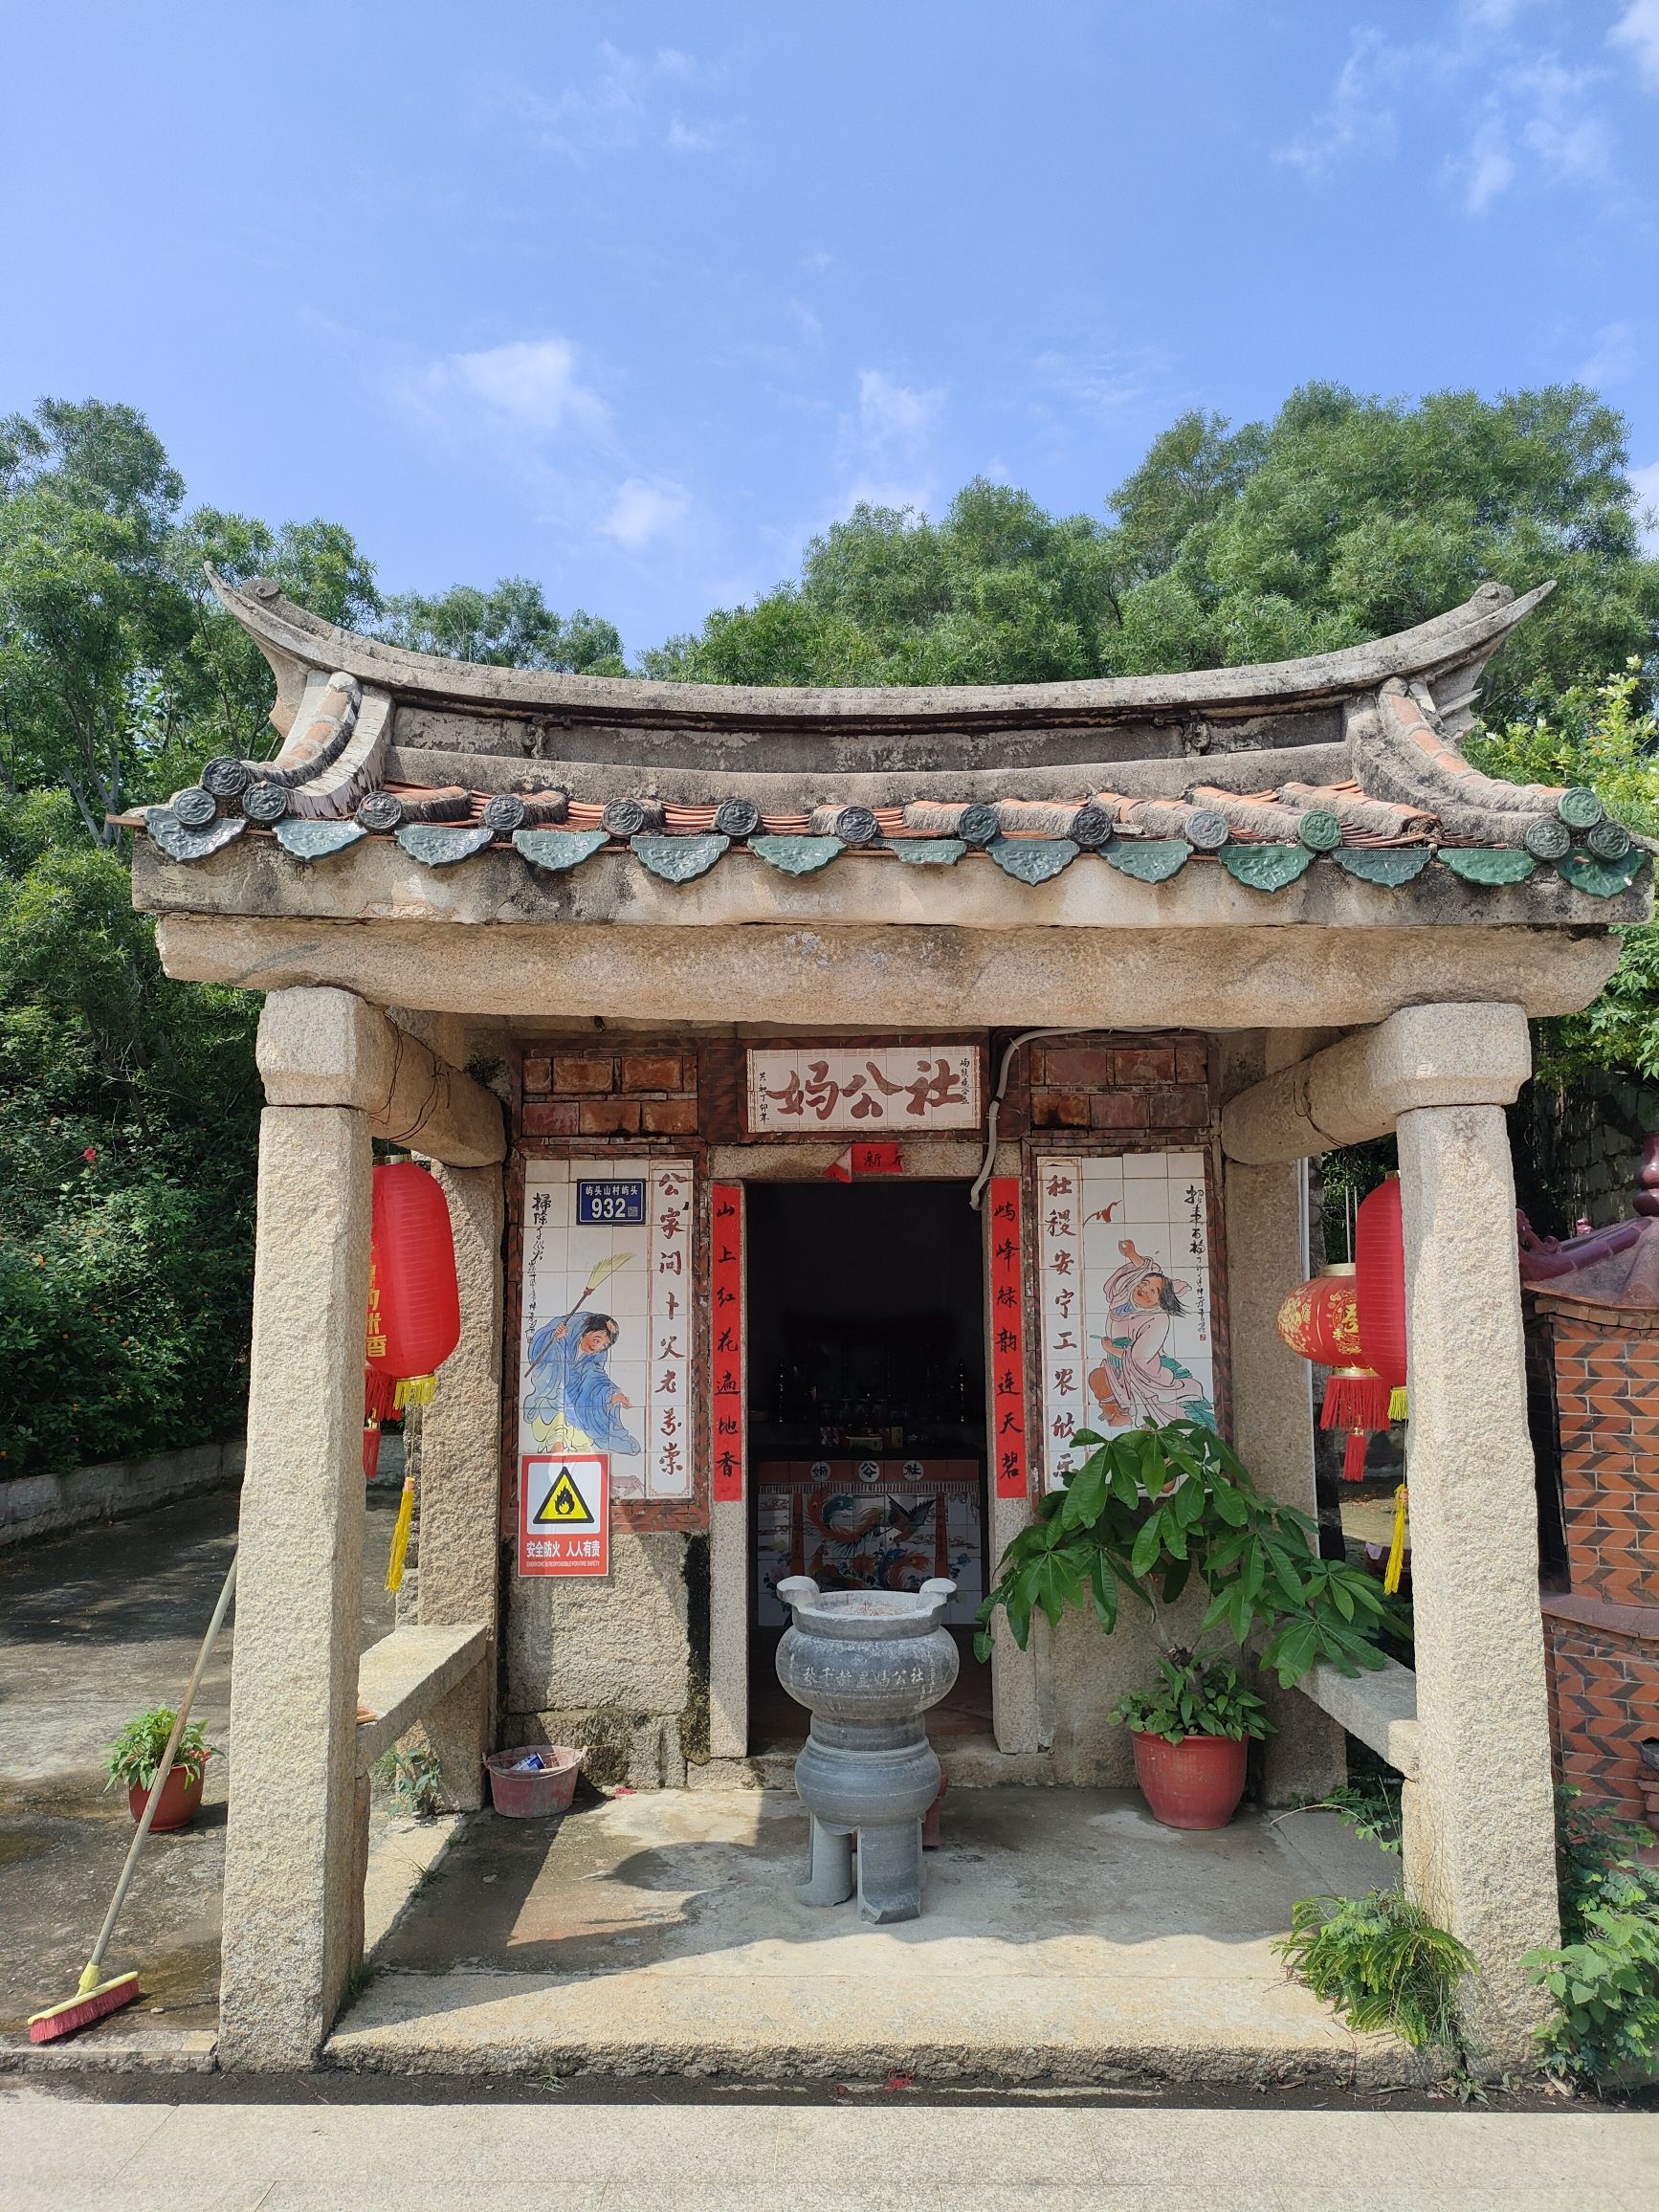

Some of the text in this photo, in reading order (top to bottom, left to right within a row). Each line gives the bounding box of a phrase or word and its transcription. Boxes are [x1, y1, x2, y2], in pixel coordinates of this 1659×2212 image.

[585, 1184, 638, 1196] 屿头山村屿头
[591, 1198, 626, 1218] 932
[526, 1539, 600, 1558] 安全防火 人人有责
